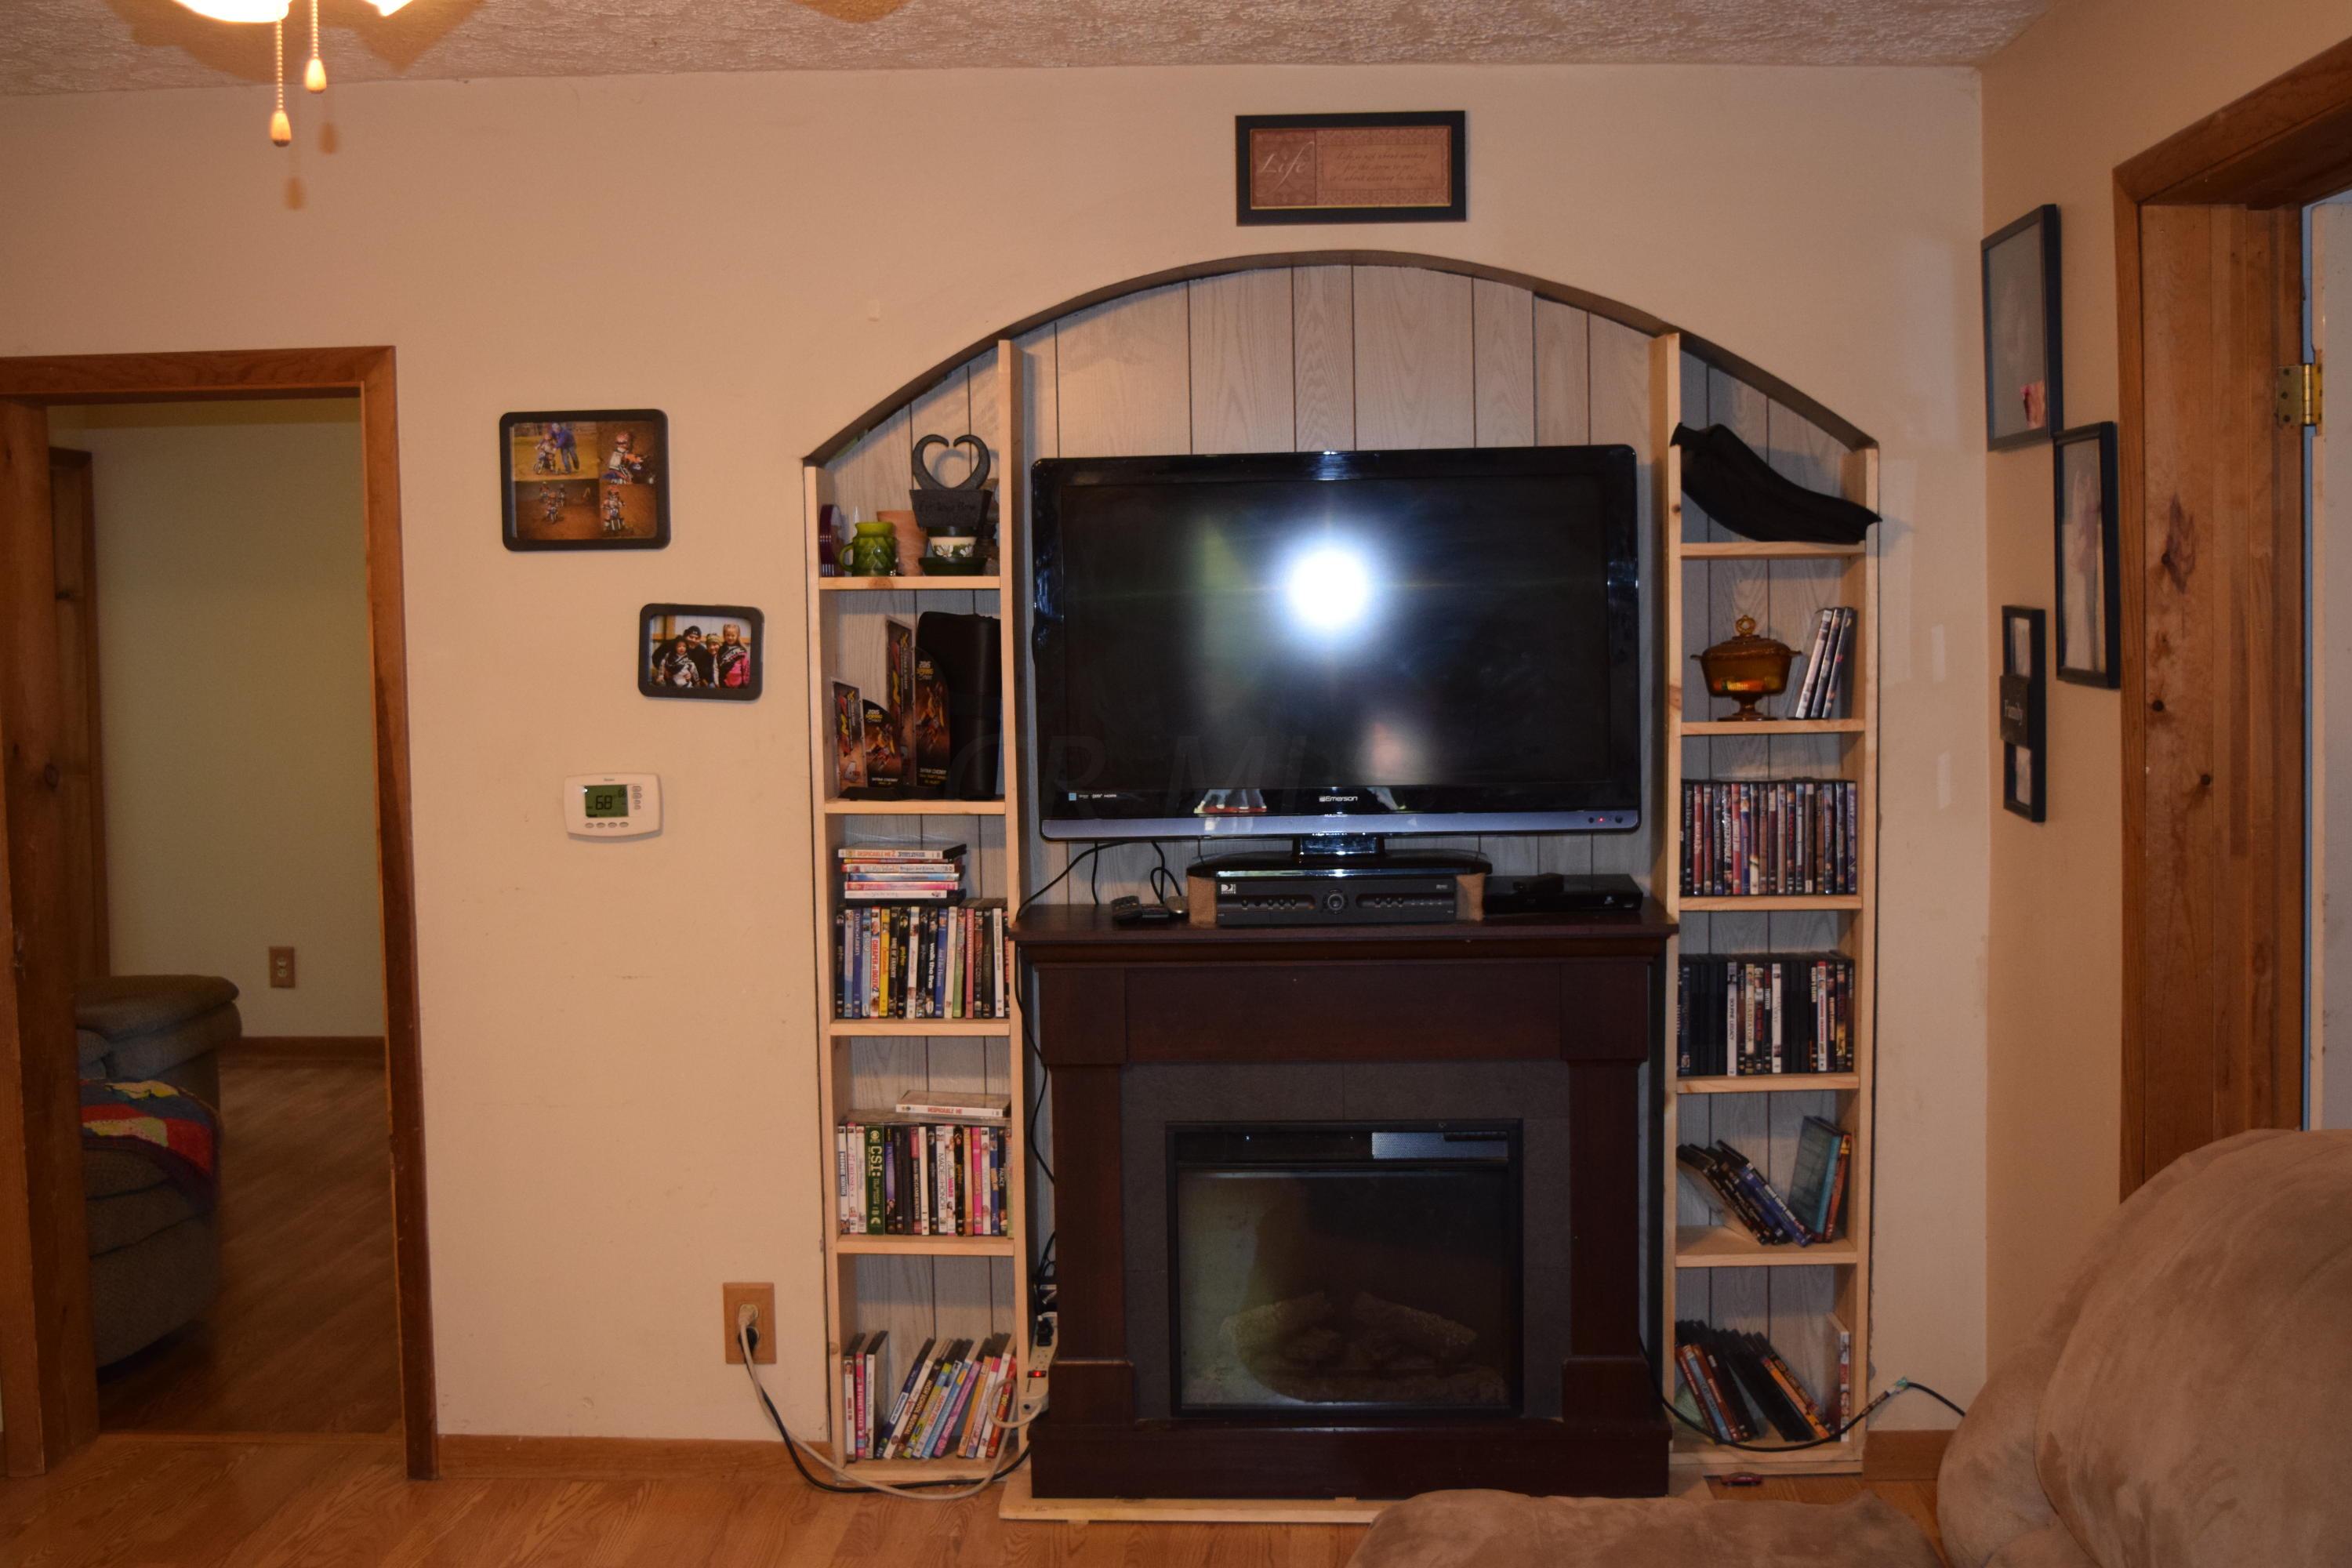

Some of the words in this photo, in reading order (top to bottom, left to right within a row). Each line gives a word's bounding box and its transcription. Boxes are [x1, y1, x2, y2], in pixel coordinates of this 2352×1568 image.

[1256, 141, 1314, 198] Life
[596, 795, 613, 810] 68
[871, 1145, 882, 1177] CSI:
